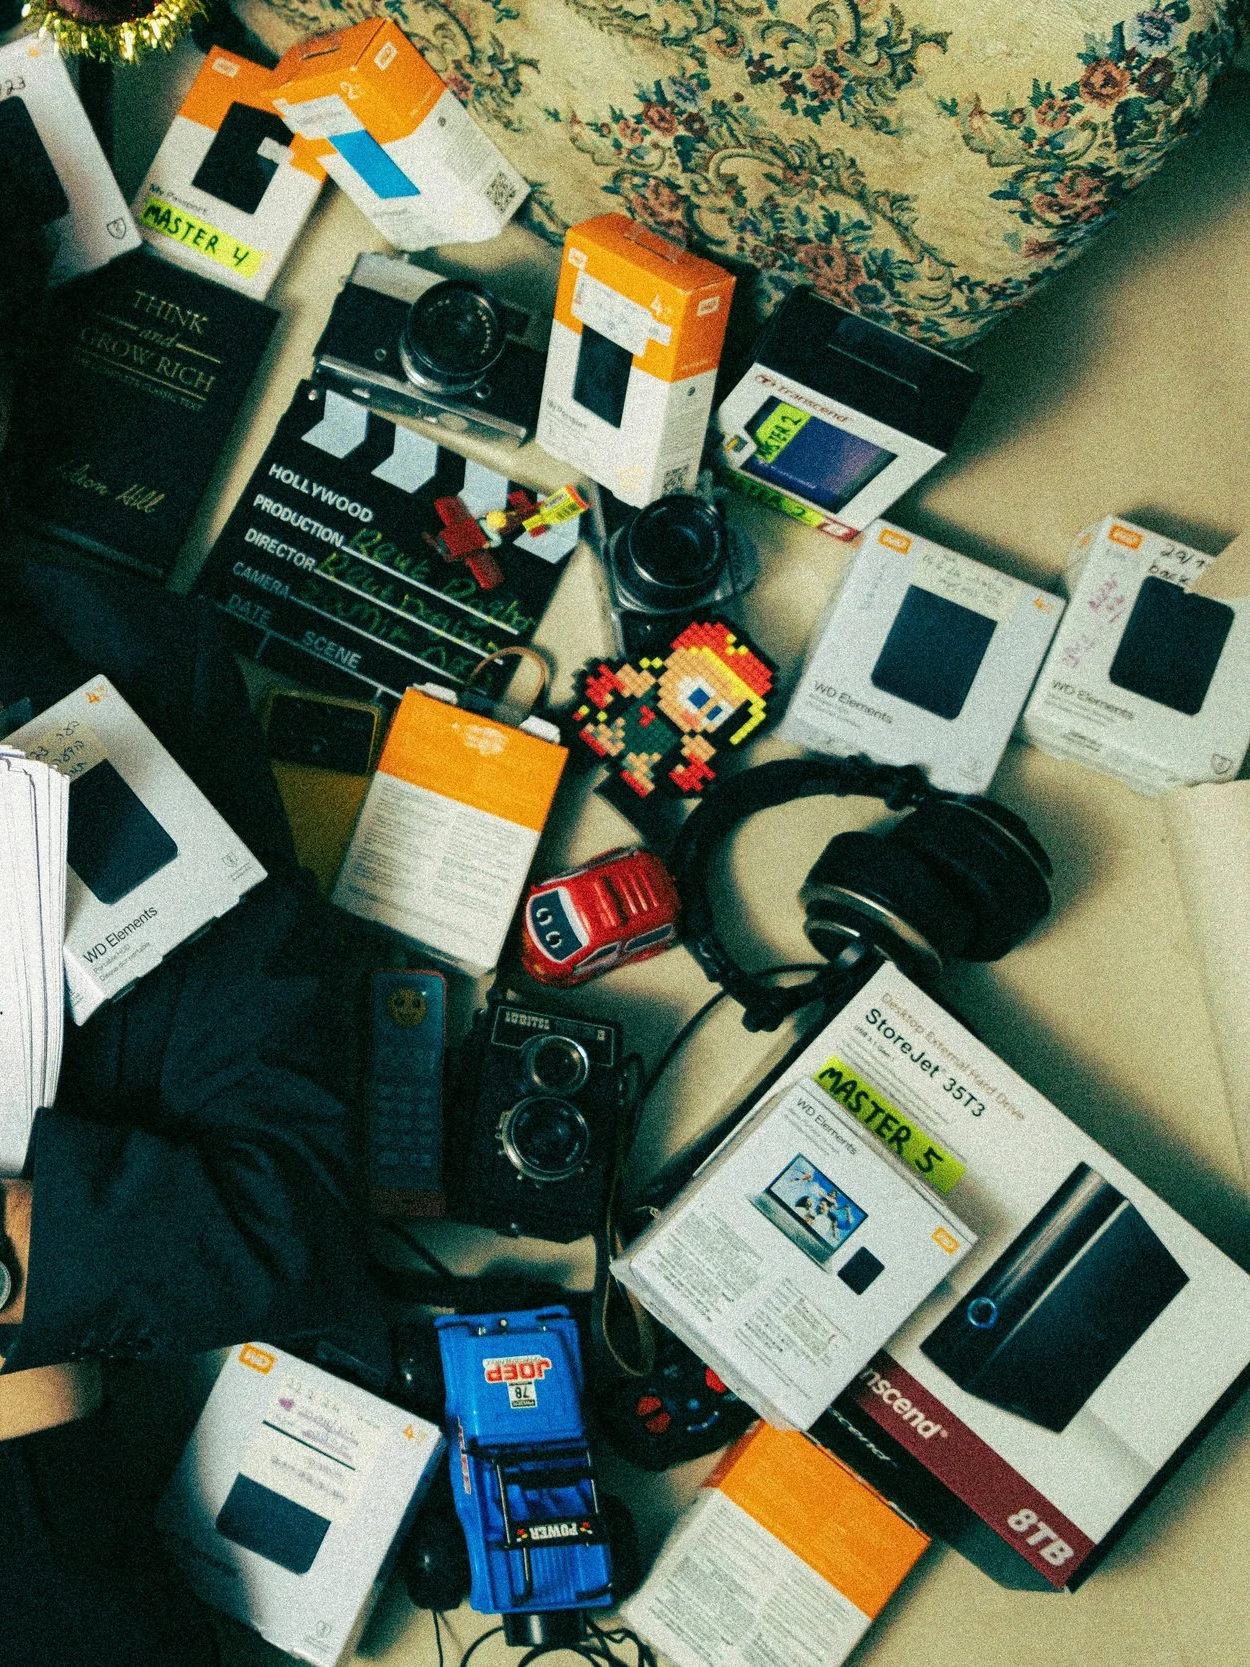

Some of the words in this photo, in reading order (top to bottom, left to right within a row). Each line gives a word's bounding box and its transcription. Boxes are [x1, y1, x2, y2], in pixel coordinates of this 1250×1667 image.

[142, 204, 220, 255] MASTER
[233, 246, 250, 268] 4
[135, 290, 209, 336] THINK
[138, 328, 180, 348] and
[80, 325, 155, 367] GROW
[155, 355, 217, 393] RICH
[780, 415, 802, 426] 2
[252, 492, 344, 550] PRODUCTION
[268, 462, 373, 523] HOLLYWOOD
[244, 527, 317, 572] DIRECTOR
[232, 561, 292, 601] CAMERA
[229, 593, 272, 627] DATE
[301, 630, 363, 671] SCENE
[813, 679, 838, 699] WD
[837, 692, 894, 726] Elements
[1076, 690, 1135, 721] Elements
[82, 941, 109, 966] WD
[105, 904, 160, 948] Elements
[882, 992, 926, 1035] Desktop
[925, 1031, 971, 1073] External
[969, 1068, 998, 1095] Hard
[996, 1092, 1025, 1122] Drive
[795, 1096, 817, 1117] WD
[814, 1110, 858, 1157] Elements
[818, 1065, 914, 1156] MASTER
[914, 1146, 944, 1175] 5
[942, 1077, 987, 1118] 35T3
[485, 1358, 551, 1383] JOEP
[859, 1367, 939, 1440] nscend
[529, 1522, 580, 1541] POWER
[1007, 1507, 1075, 1568] 8TB
